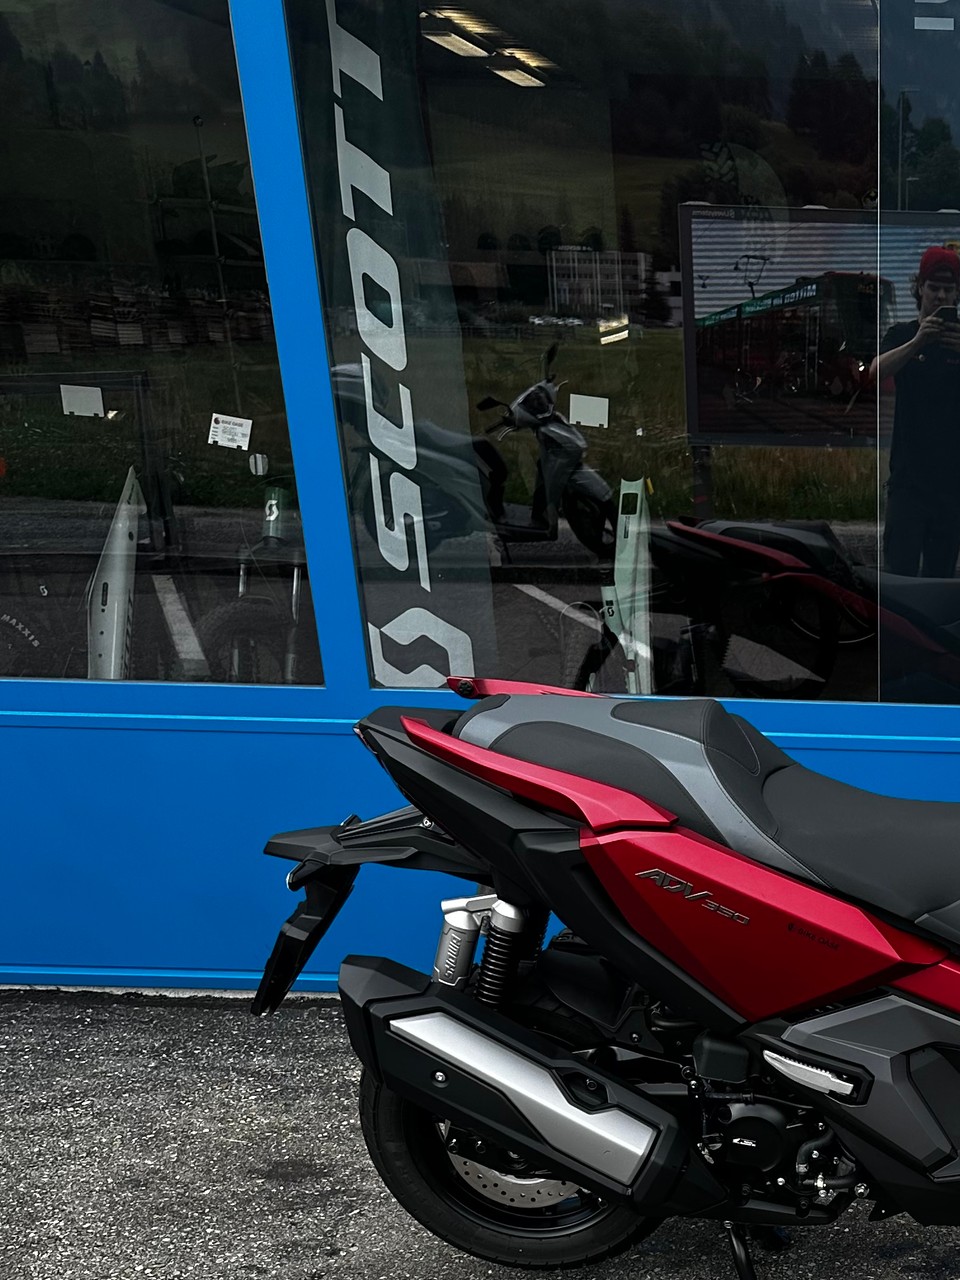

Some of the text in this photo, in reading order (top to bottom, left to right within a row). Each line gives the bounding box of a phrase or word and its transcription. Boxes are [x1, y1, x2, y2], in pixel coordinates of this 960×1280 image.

[326, 0, 431, 593] SCOTT
[0, 614, 41, 648] MAXXIS
[444, 933, 462, 978] SHOWA
